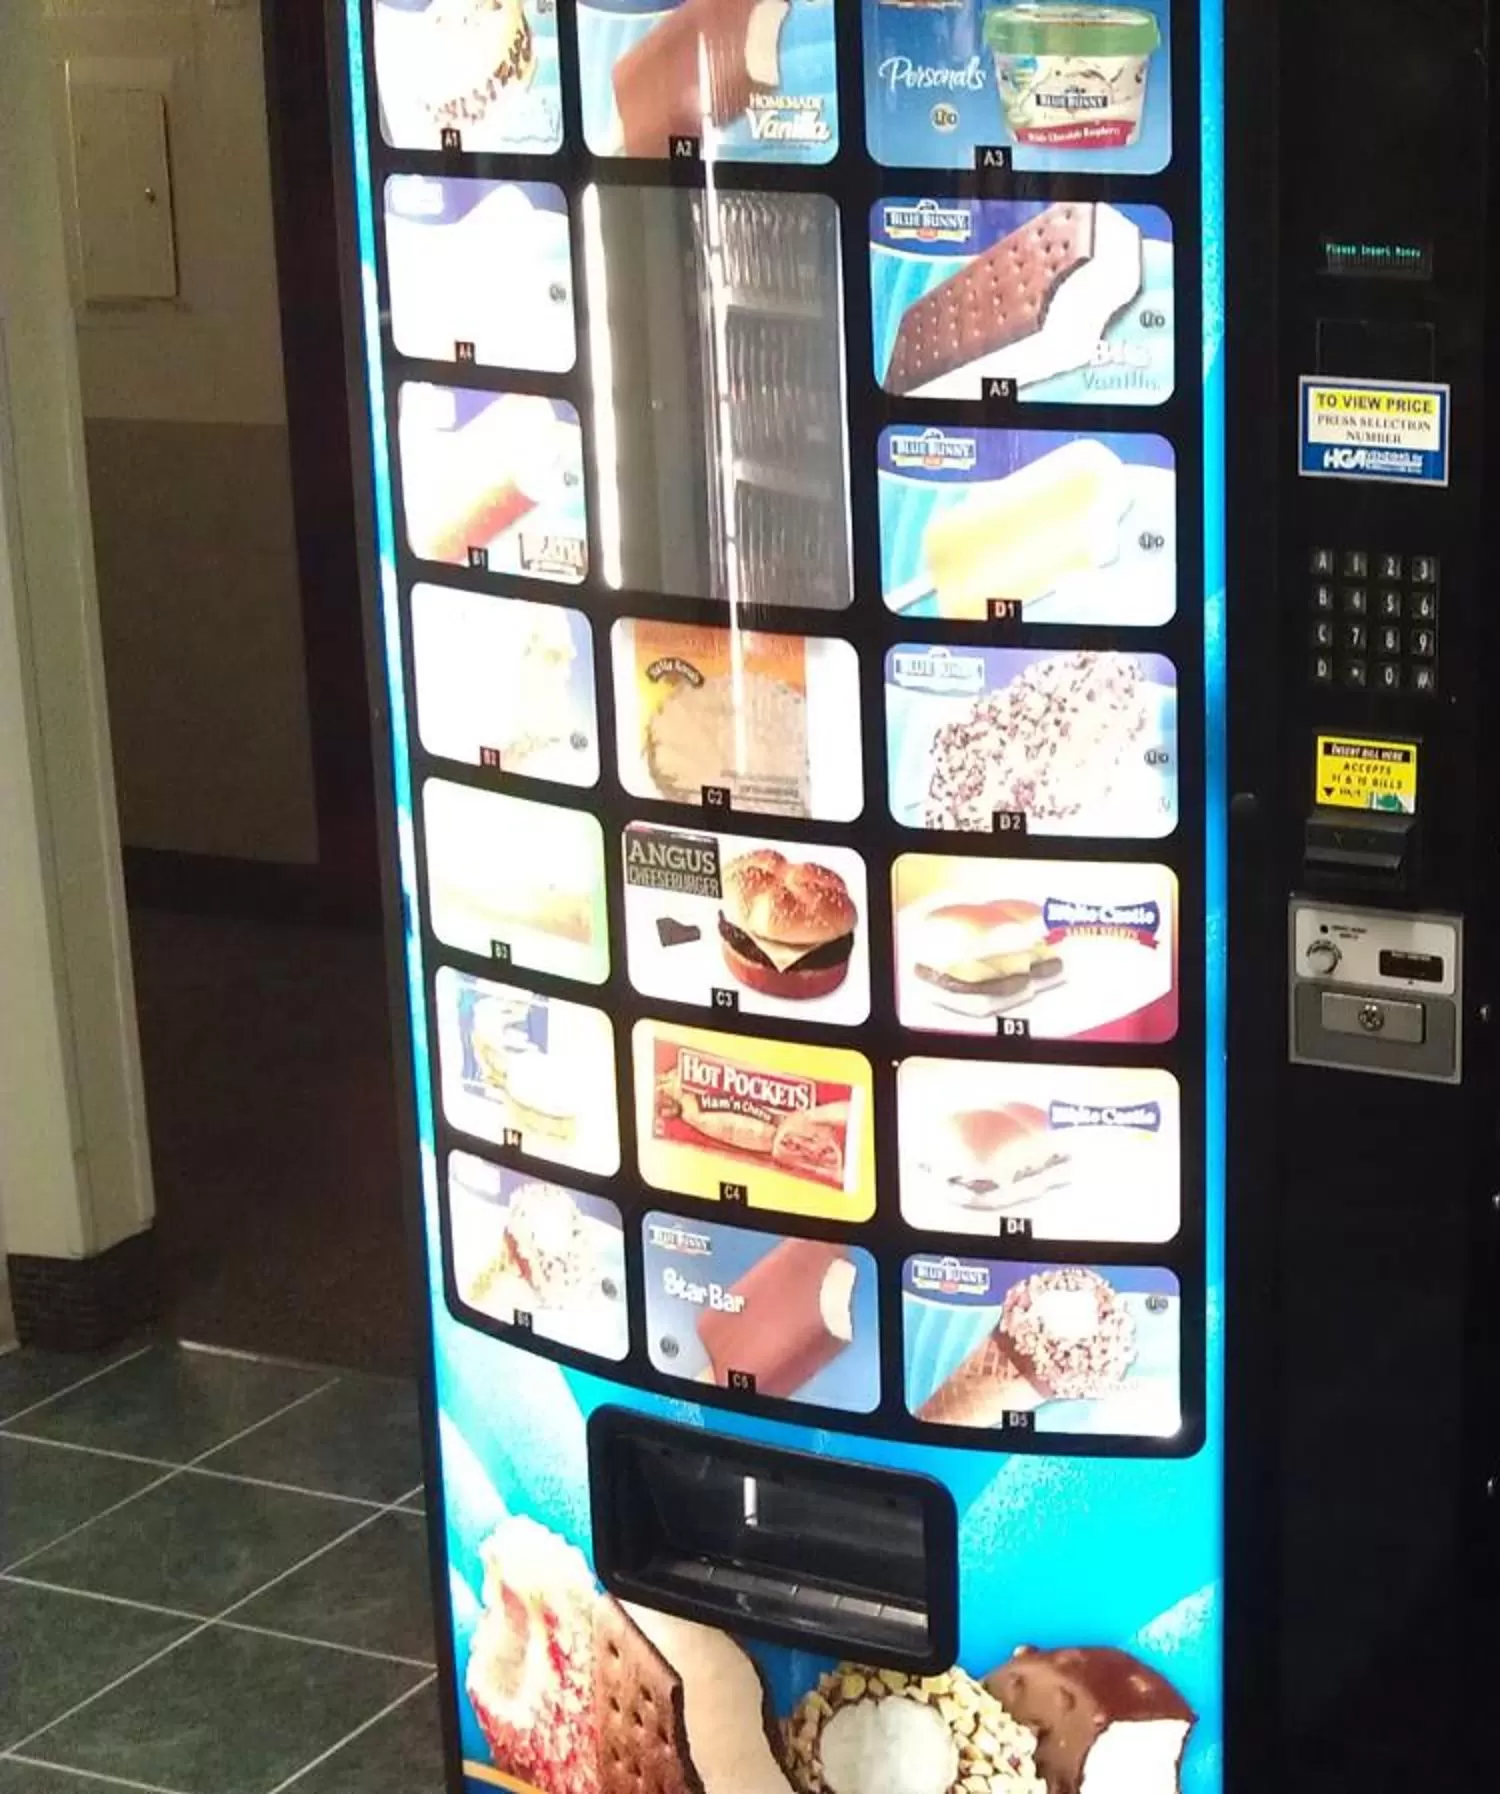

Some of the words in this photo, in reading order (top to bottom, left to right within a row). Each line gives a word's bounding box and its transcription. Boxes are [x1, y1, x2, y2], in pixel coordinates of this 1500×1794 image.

[878, 55, 986, 92] Personals
[749, 93, 824, 110] HOMEMADE
[746, 107, 832, 141] Vanilla
[444, 134, 457, 148] A1
[675, 139, 693, 156] A2
[983, 150, 1004, 167] A3
[920, 213, 965, 230] BUNNY
[989, 381, 1010, 397] A5
[1317, 393, 1338, 409] TO
[1342, 395, 1381, 411] VIEW
[1387, 398, 1433, 414] PRICE
[1317, 414, 1358, 426] PRESS
[1359, 416, 1431, 432] SELECTION
[1346, 430, 1402, 444] NUMBER
[994, 601, 1016, 618] D1
[1420, 597, 1429, 616] 6
[1419, 633, 1428, 652] 9
[1385, 666, 1393, 685] 0
[1343, 761, 1392, 776] ACCEPTS
[1372, 777, 1402, 790] BILLS
[706, 788, 723, 805] C2
[999, 814, 1022, 831] D2
[628, 839, 716, 874] ANGUS
[628, 868, 720, 896] CHEESEBURGER
[715, 991, 733, 1006] C3
[1003, 1019, 1026, 1036] D3
[682, 1054, 722, 1089] HOT
[723, 1064, 809, 1109] POCKETS
[724, 1187, 741, 1200] C4
[1007, 1219, 1026, 1234] D4
[662, 1267, 709, 1305] Star
[708, 1283, 746, 1314] Bar
[1009, 1412, 1028, 1428] D5
